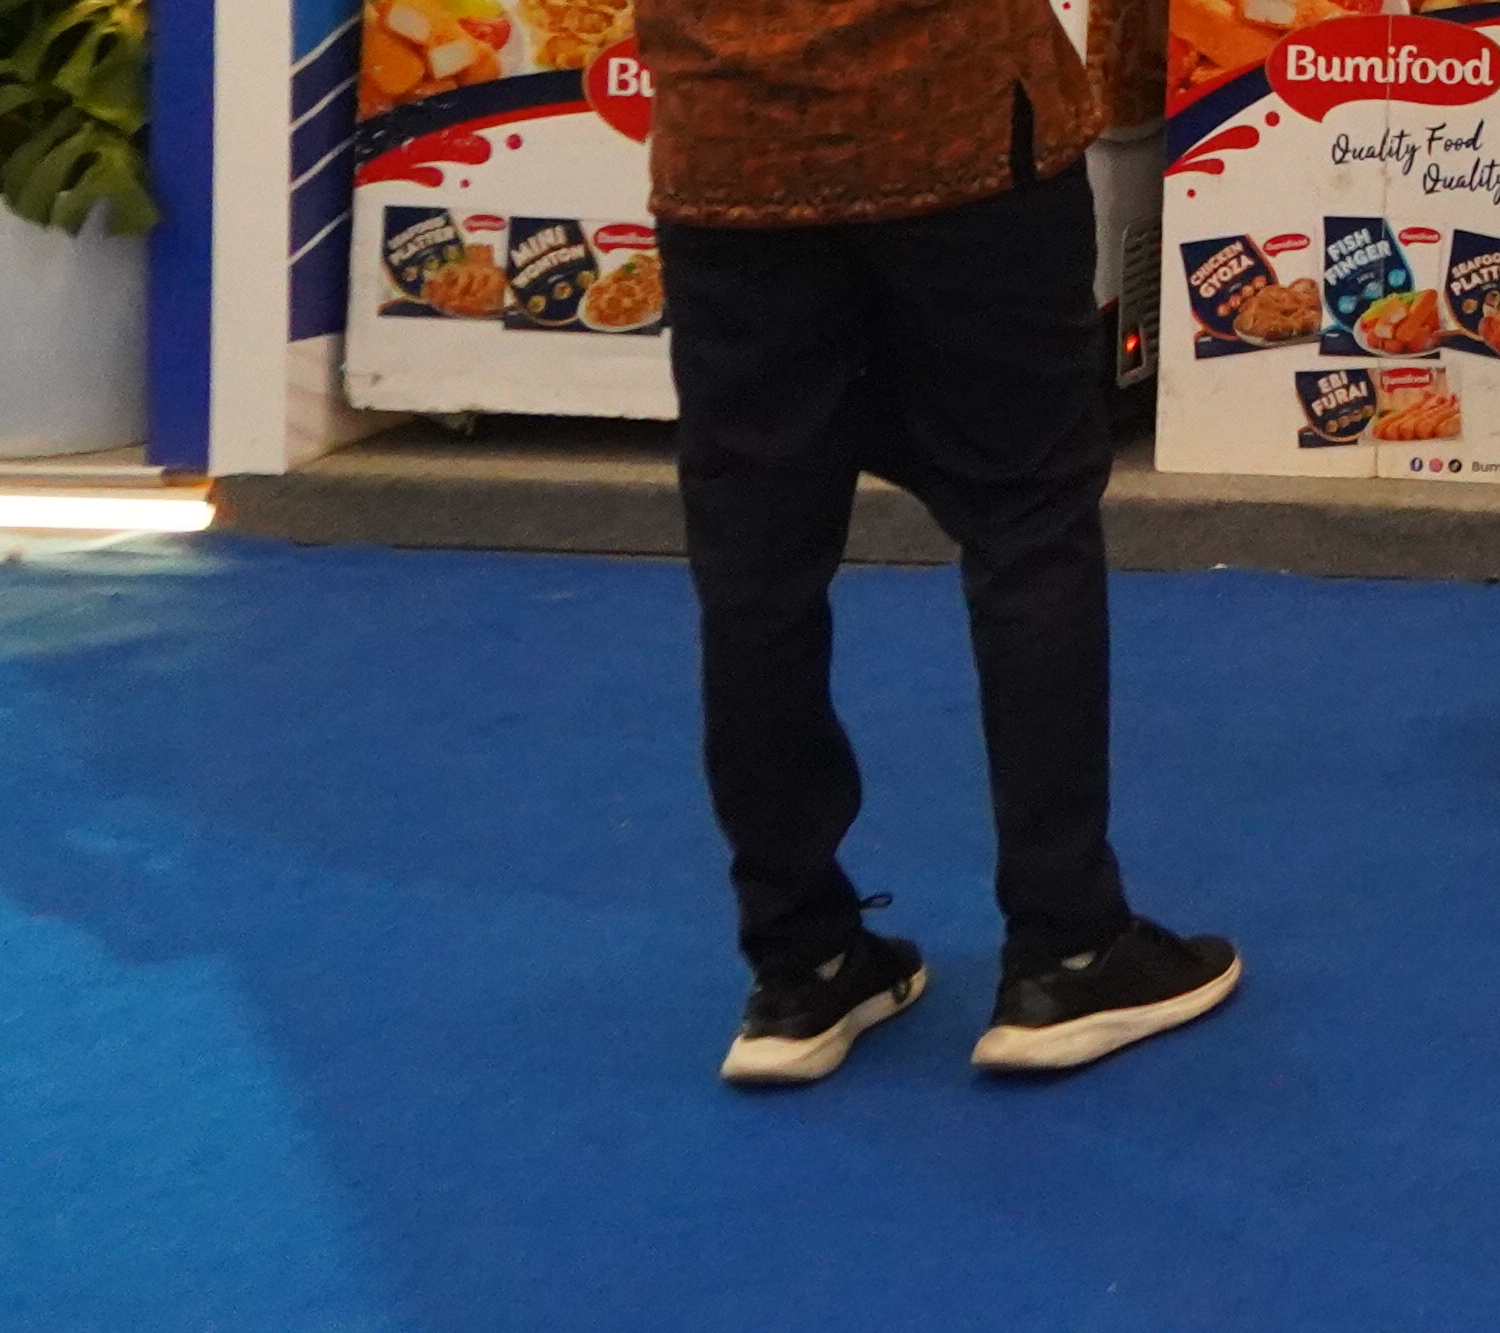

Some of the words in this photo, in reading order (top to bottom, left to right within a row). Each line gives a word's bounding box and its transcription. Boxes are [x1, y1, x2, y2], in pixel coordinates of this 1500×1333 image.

[1286, 45, 1494, 85] Bumifood
[1332, 128, 1423, 175] Quality
[1426, 119, 1485, 156] Food
[1323, 239, 1393, 286] FINGER
[1326, 227, 1371, 261] FISH
[1198, 255, 1256, 300] GYOZA
[1311, 380, 1369, 418] FURAI
[1316, 370, 1349, 396] EBI
